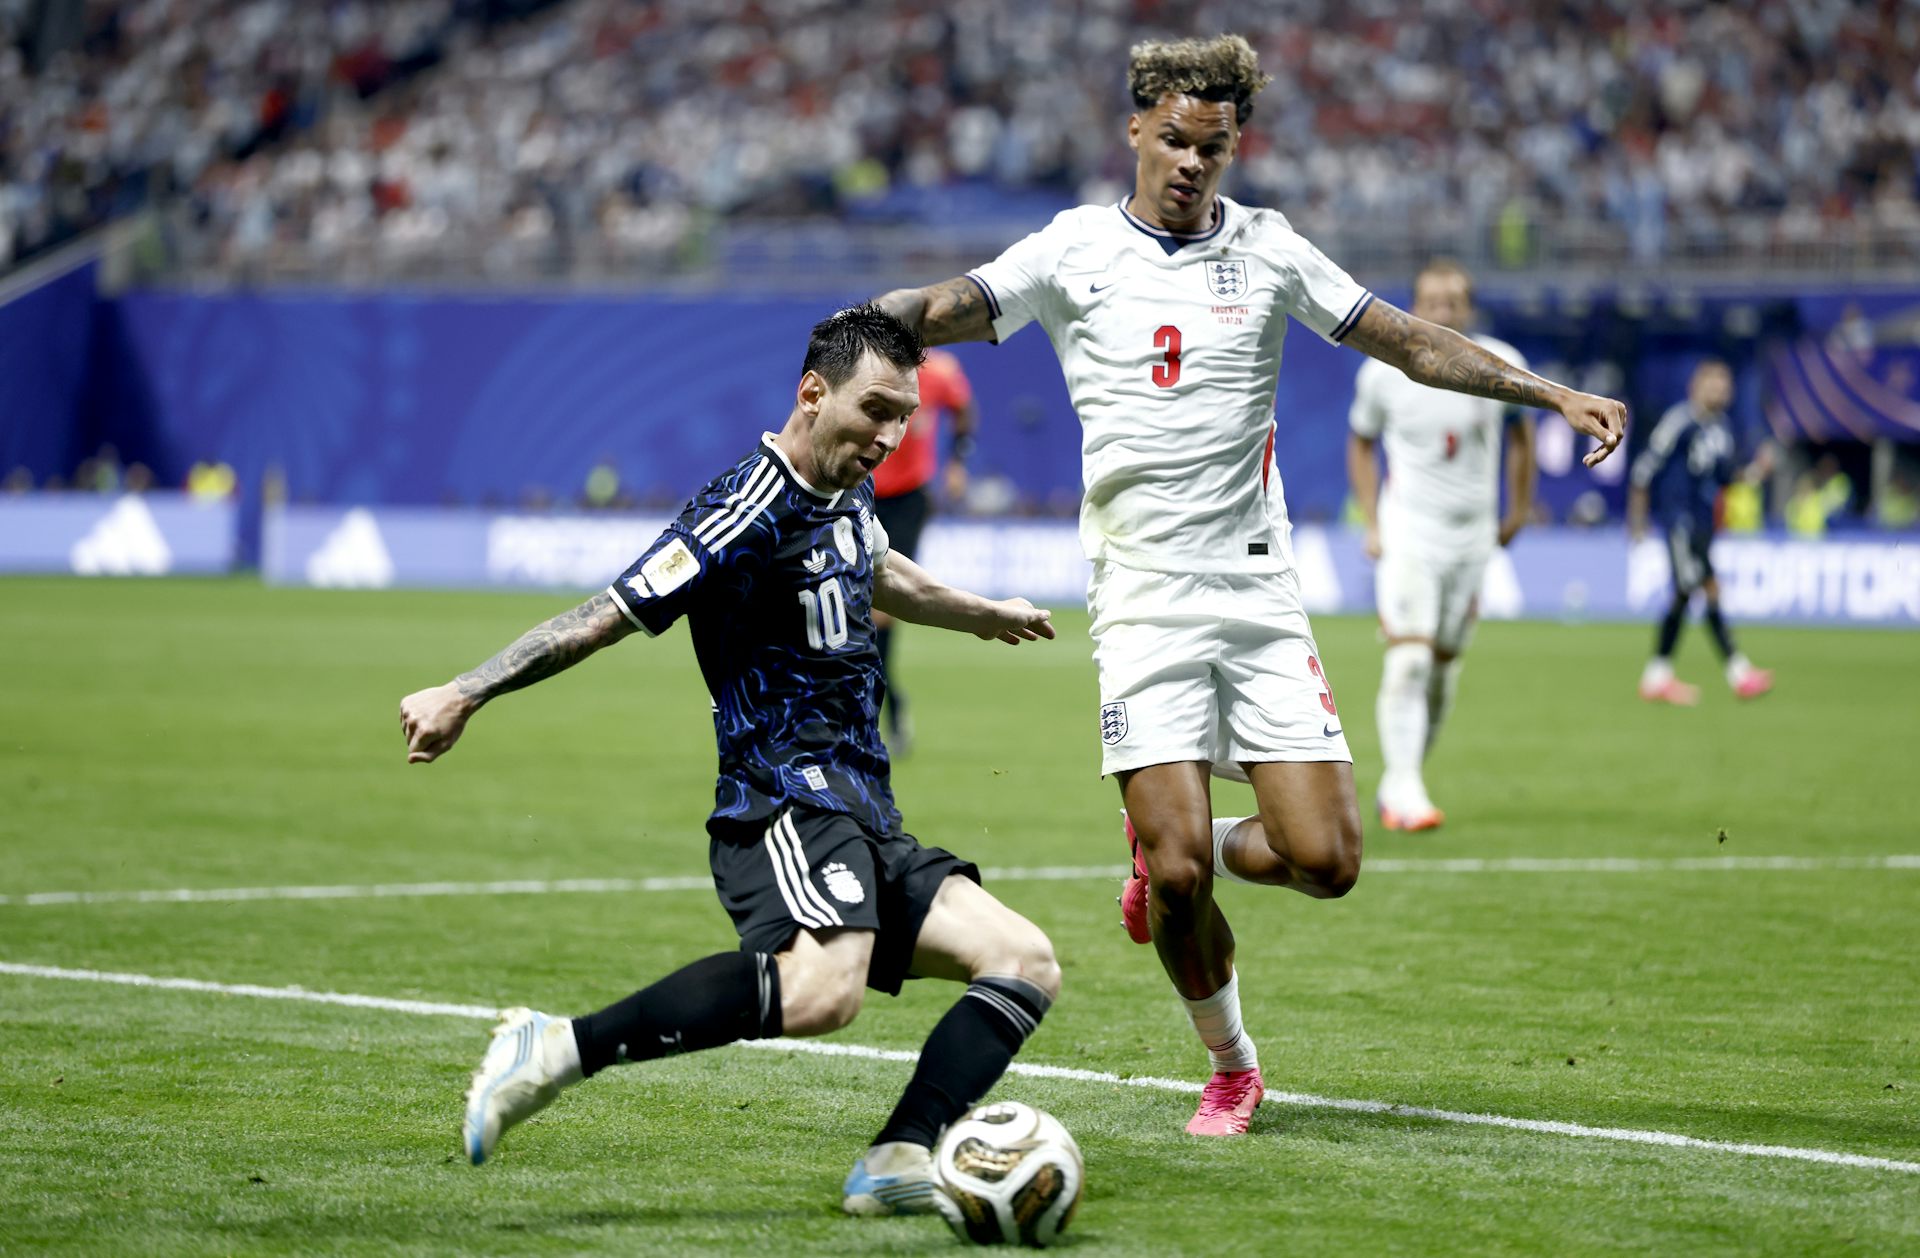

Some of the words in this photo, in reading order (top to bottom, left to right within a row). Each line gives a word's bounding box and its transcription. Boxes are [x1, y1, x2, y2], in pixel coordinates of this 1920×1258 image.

[1210, 306, 1249, 315] ARGENTINA
[1152, 325, 1182, 388] 3
[1626, 537, 1920, 619] PEDATOR
[798, 577, 848, 650] 10
[1307, 655, 1336, 715] 3
